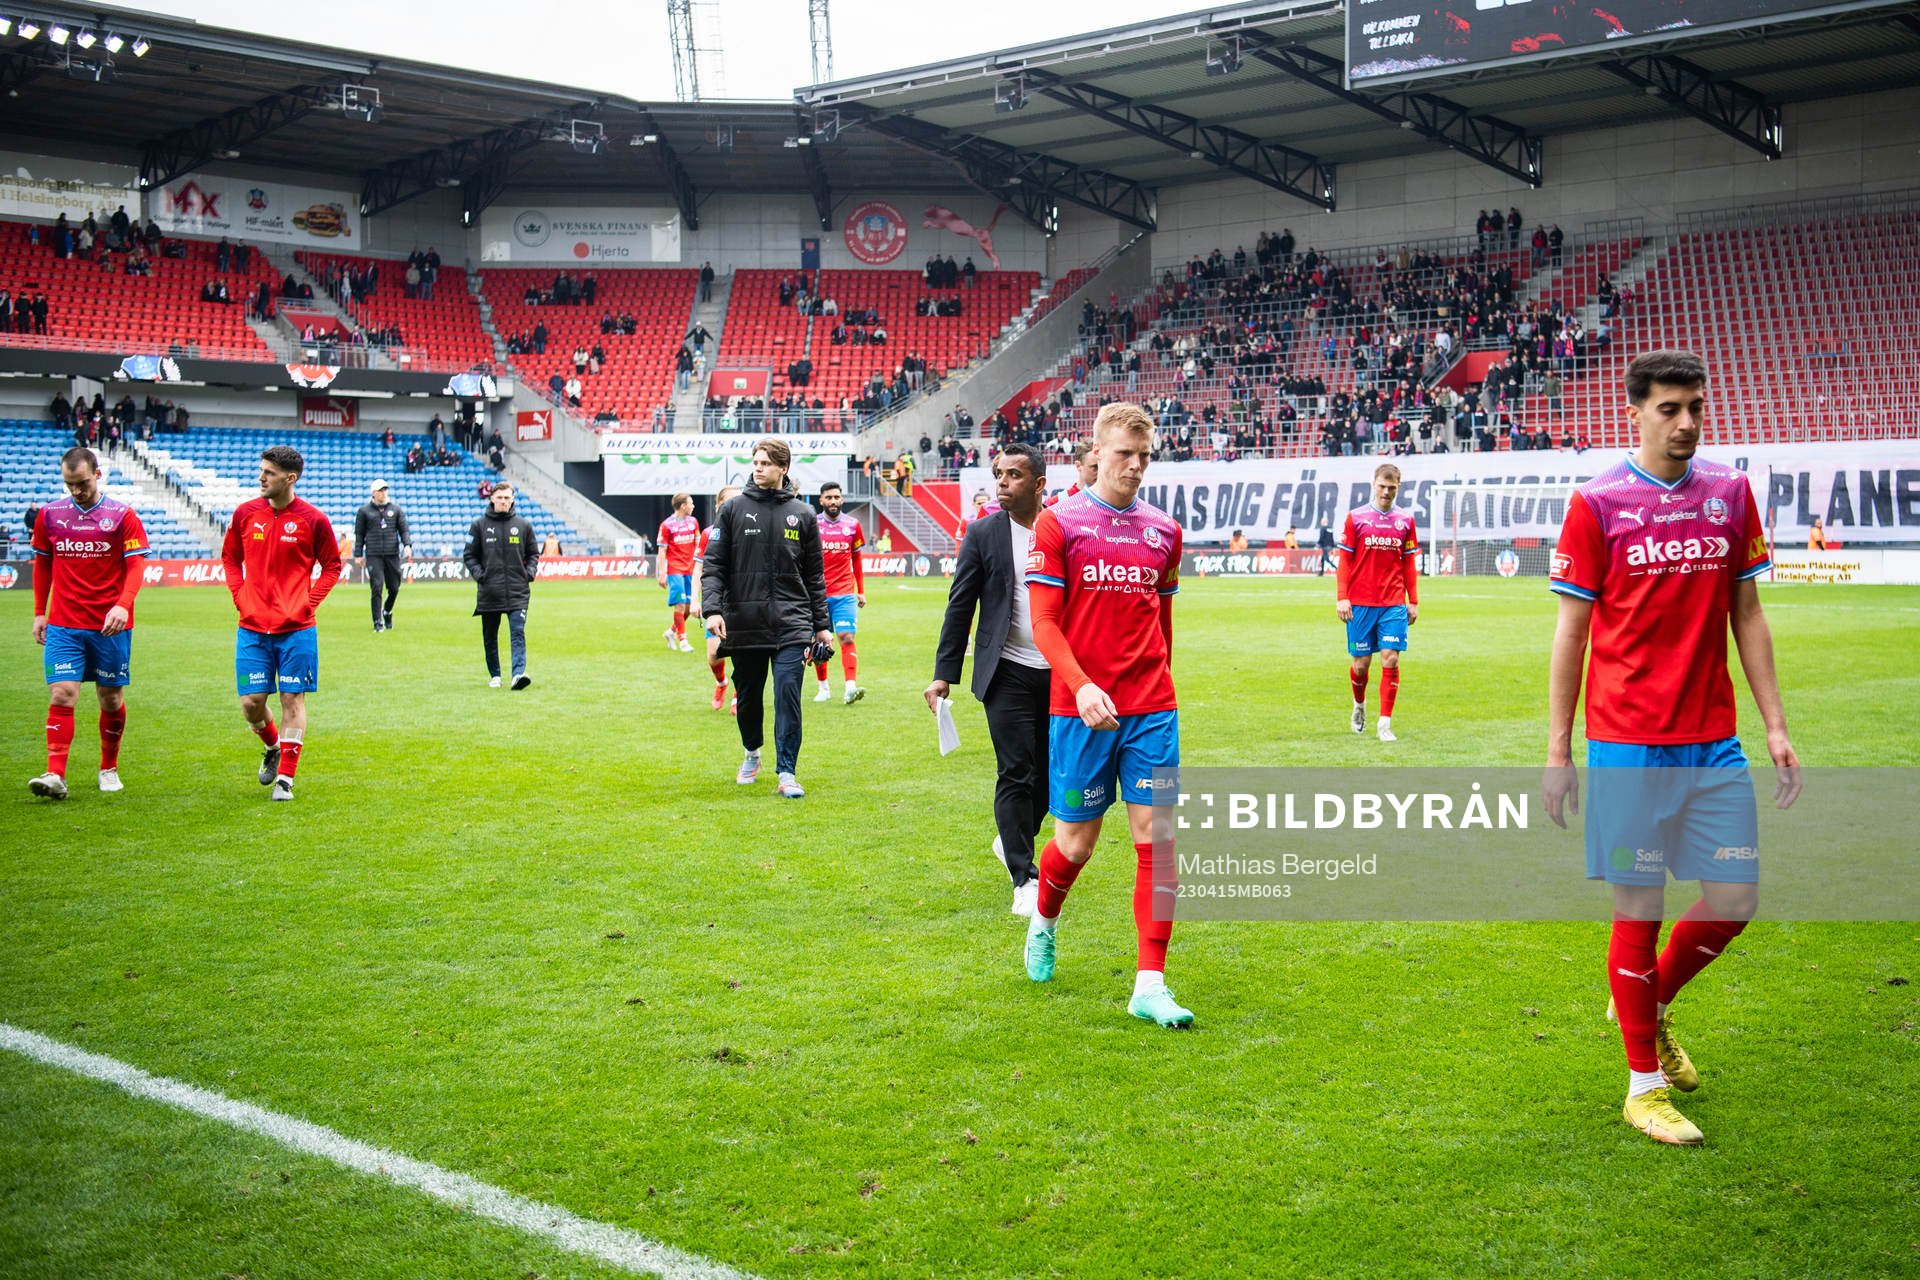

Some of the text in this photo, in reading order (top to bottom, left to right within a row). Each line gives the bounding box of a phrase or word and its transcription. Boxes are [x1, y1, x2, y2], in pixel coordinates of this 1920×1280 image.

[1368, 31, 1415, 50] TILLBAKA
[165, 180, 221, 218] MAX
[552, 221, 649, 230] SVENSKA FINANS
[592, 244, 629, 260] Hjerta
[305, 410, 343, 425] PUMA
[686, 439, 724, 449] BUSS
[1214, 482, 1265, 530] DIG
[1268, 469, 1339, 530] FÖR
[1653, 510, 1698, 524] kondektor
[784, 528, 800, 541] XXL
[55, 538, 95, 552] akea
[822, 540, 841, 550] kea
[1626, 536, 1702, 567] akea
[401, 562, 435, 579] TACK
[536, 560, 649, 577] KOMMEN TILLBAKA
[862, 557, 907, 574] ILLBAKA
[1083, 559, 1141, 583] akea
[1193, 555, 1225, 573] TACK
[1647, 567, 1667, 576] PART
[1668, 566, 1680, 574] OF
[1084, 784, 1105, 800] Solid
[1636, 848, 1664, 862] Solid
